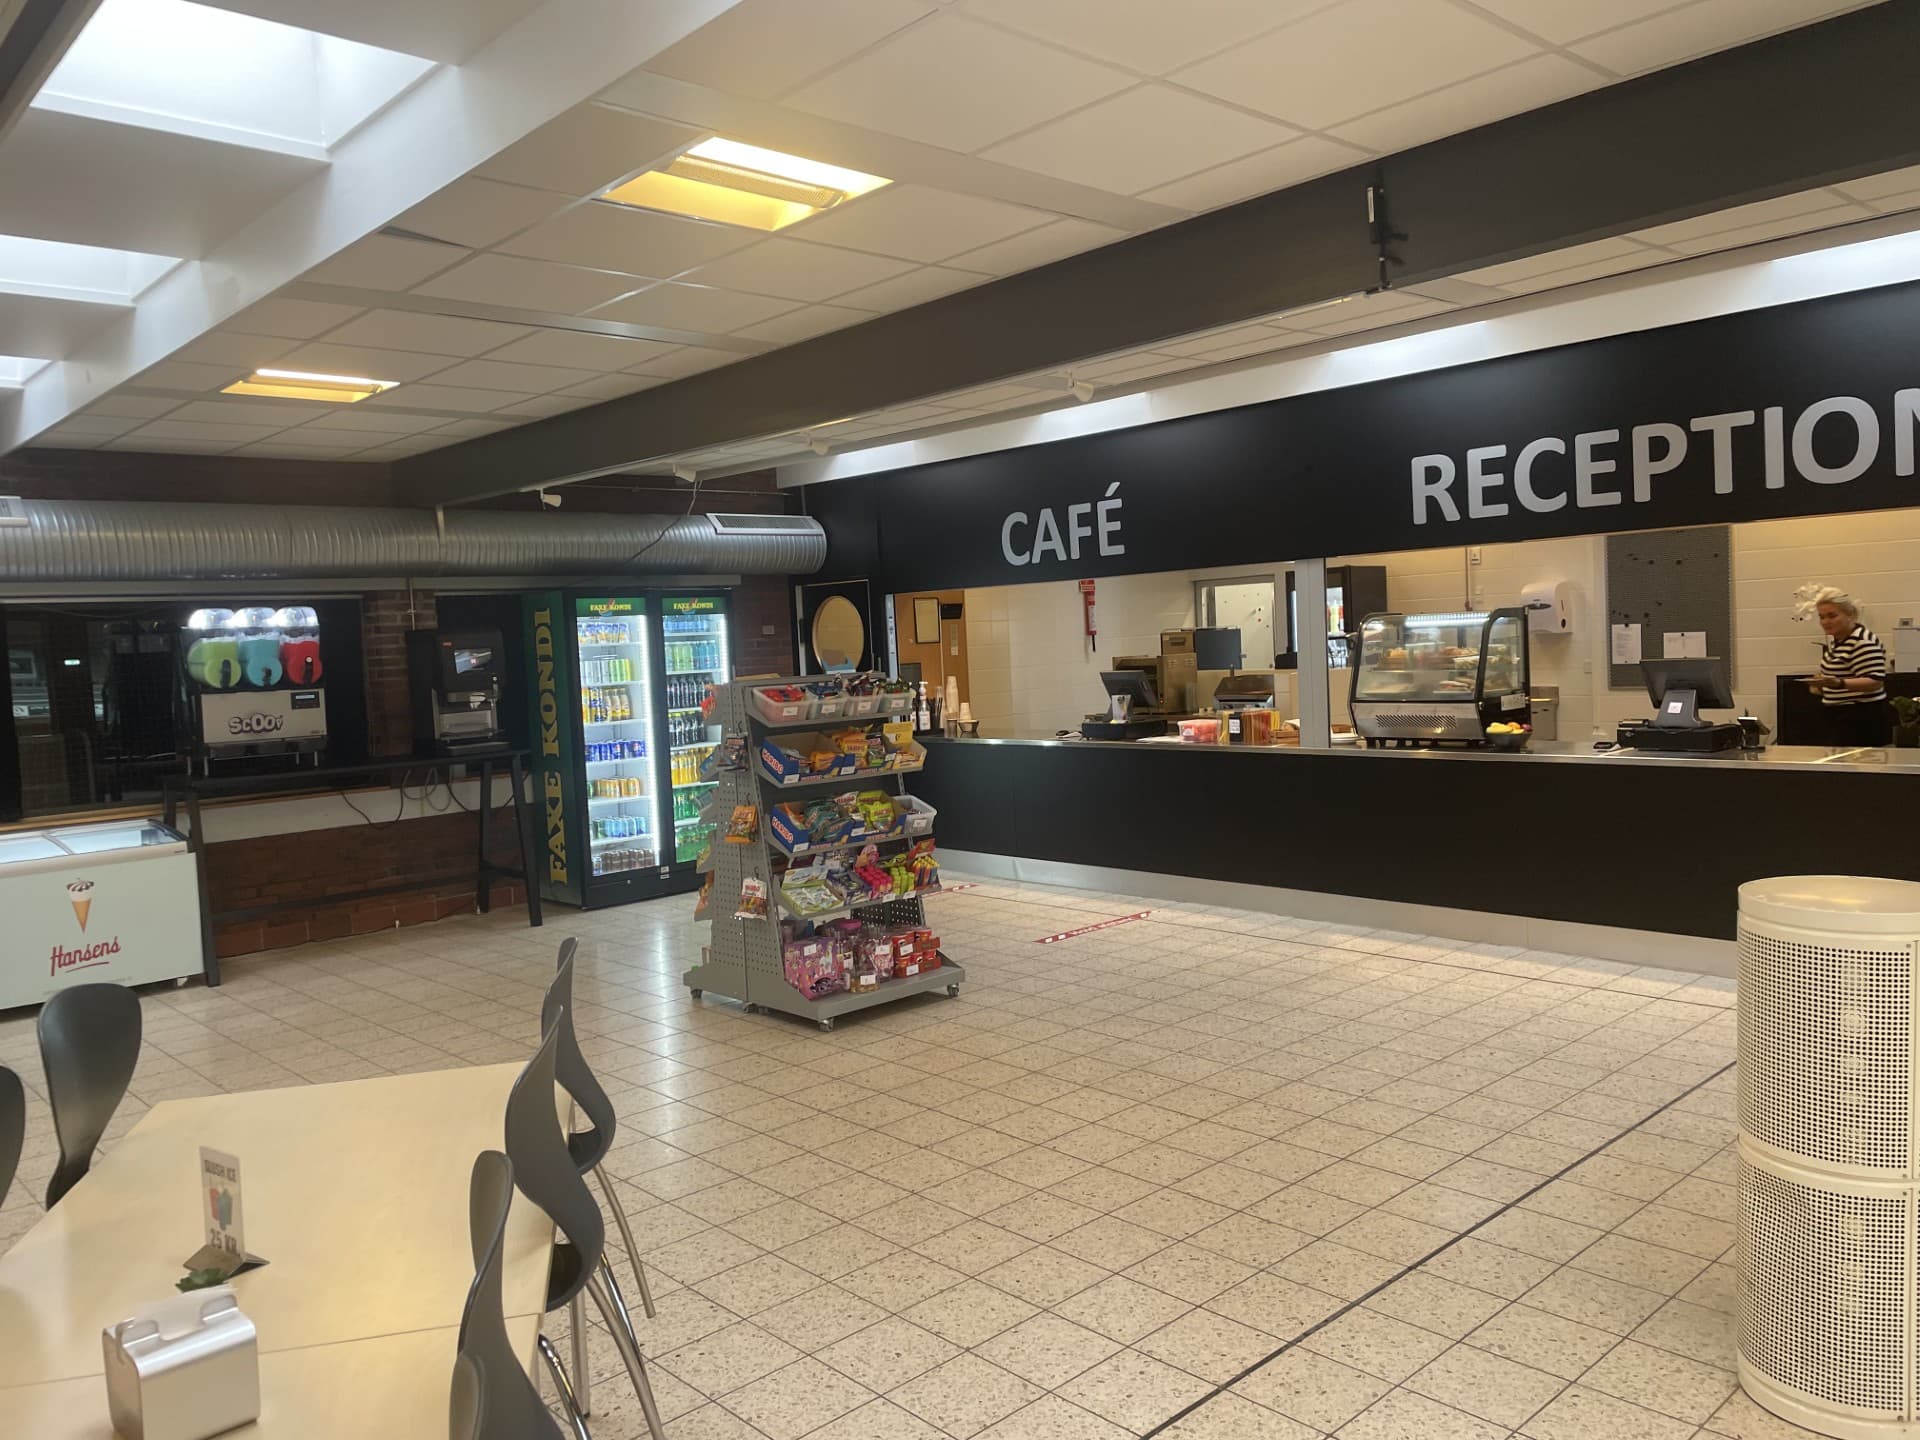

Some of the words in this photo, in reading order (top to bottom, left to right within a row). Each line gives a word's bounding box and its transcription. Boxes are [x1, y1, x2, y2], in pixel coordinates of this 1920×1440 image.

[1001, 481, 1126, 567] CAFÉ
[534, 607, 560, 758] KONDI
[545, 770, 568, 885] FAXE
[50, 936, 121, 976] Hansens
[210, 1228, 222, 1249] 25
